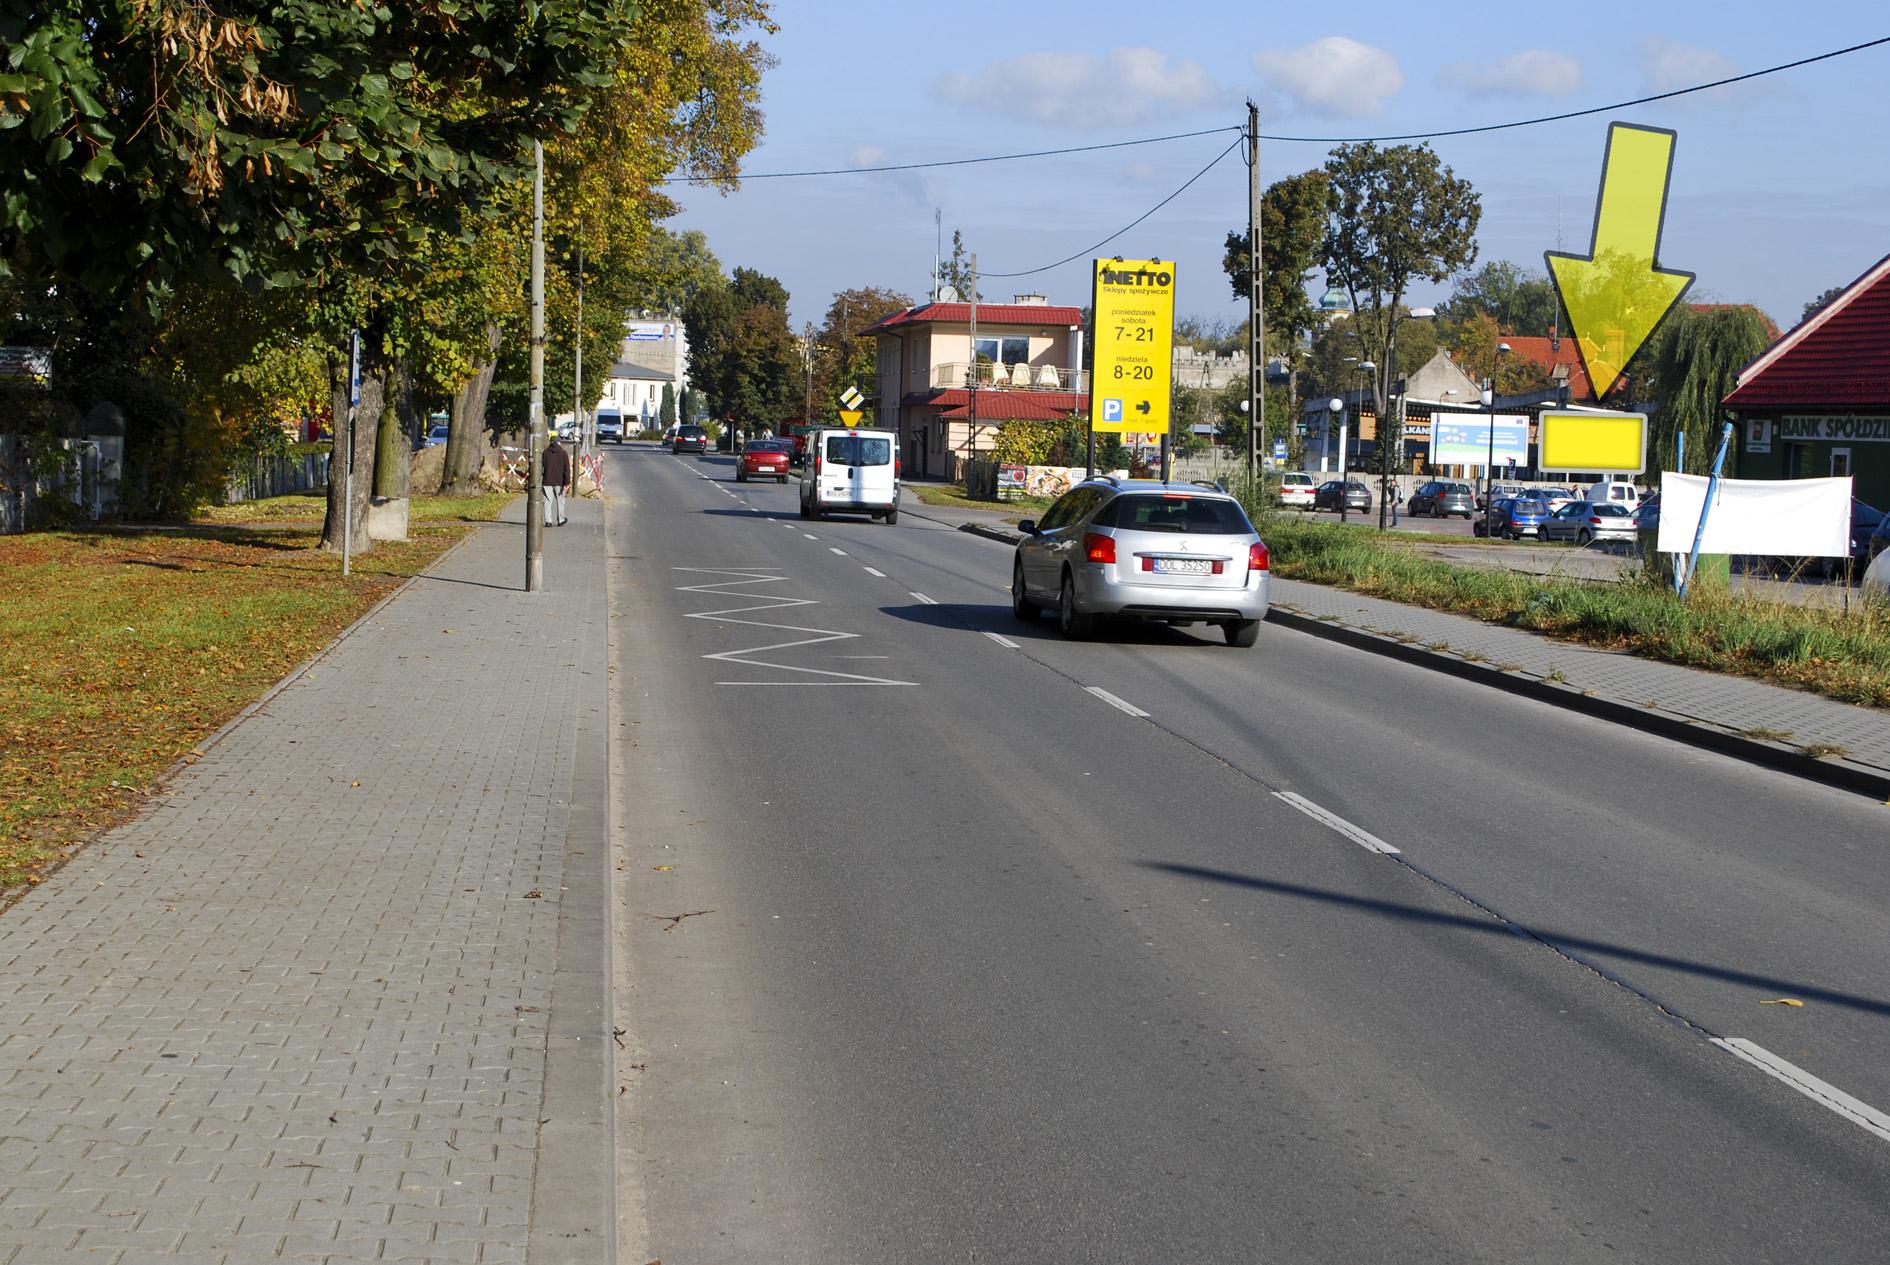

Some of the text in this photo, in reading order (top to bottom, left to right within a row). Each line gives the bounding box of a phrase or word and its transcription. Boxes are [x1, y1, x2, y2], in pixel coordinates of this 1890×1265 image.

[1103, 270, 1171, 287] NETTO
[1103, 286, 1127, 294] Sklepy
[1104, 400, 1120, 420] P
[1782, 411, 1890, 440] BANK SPÓŁDZI
